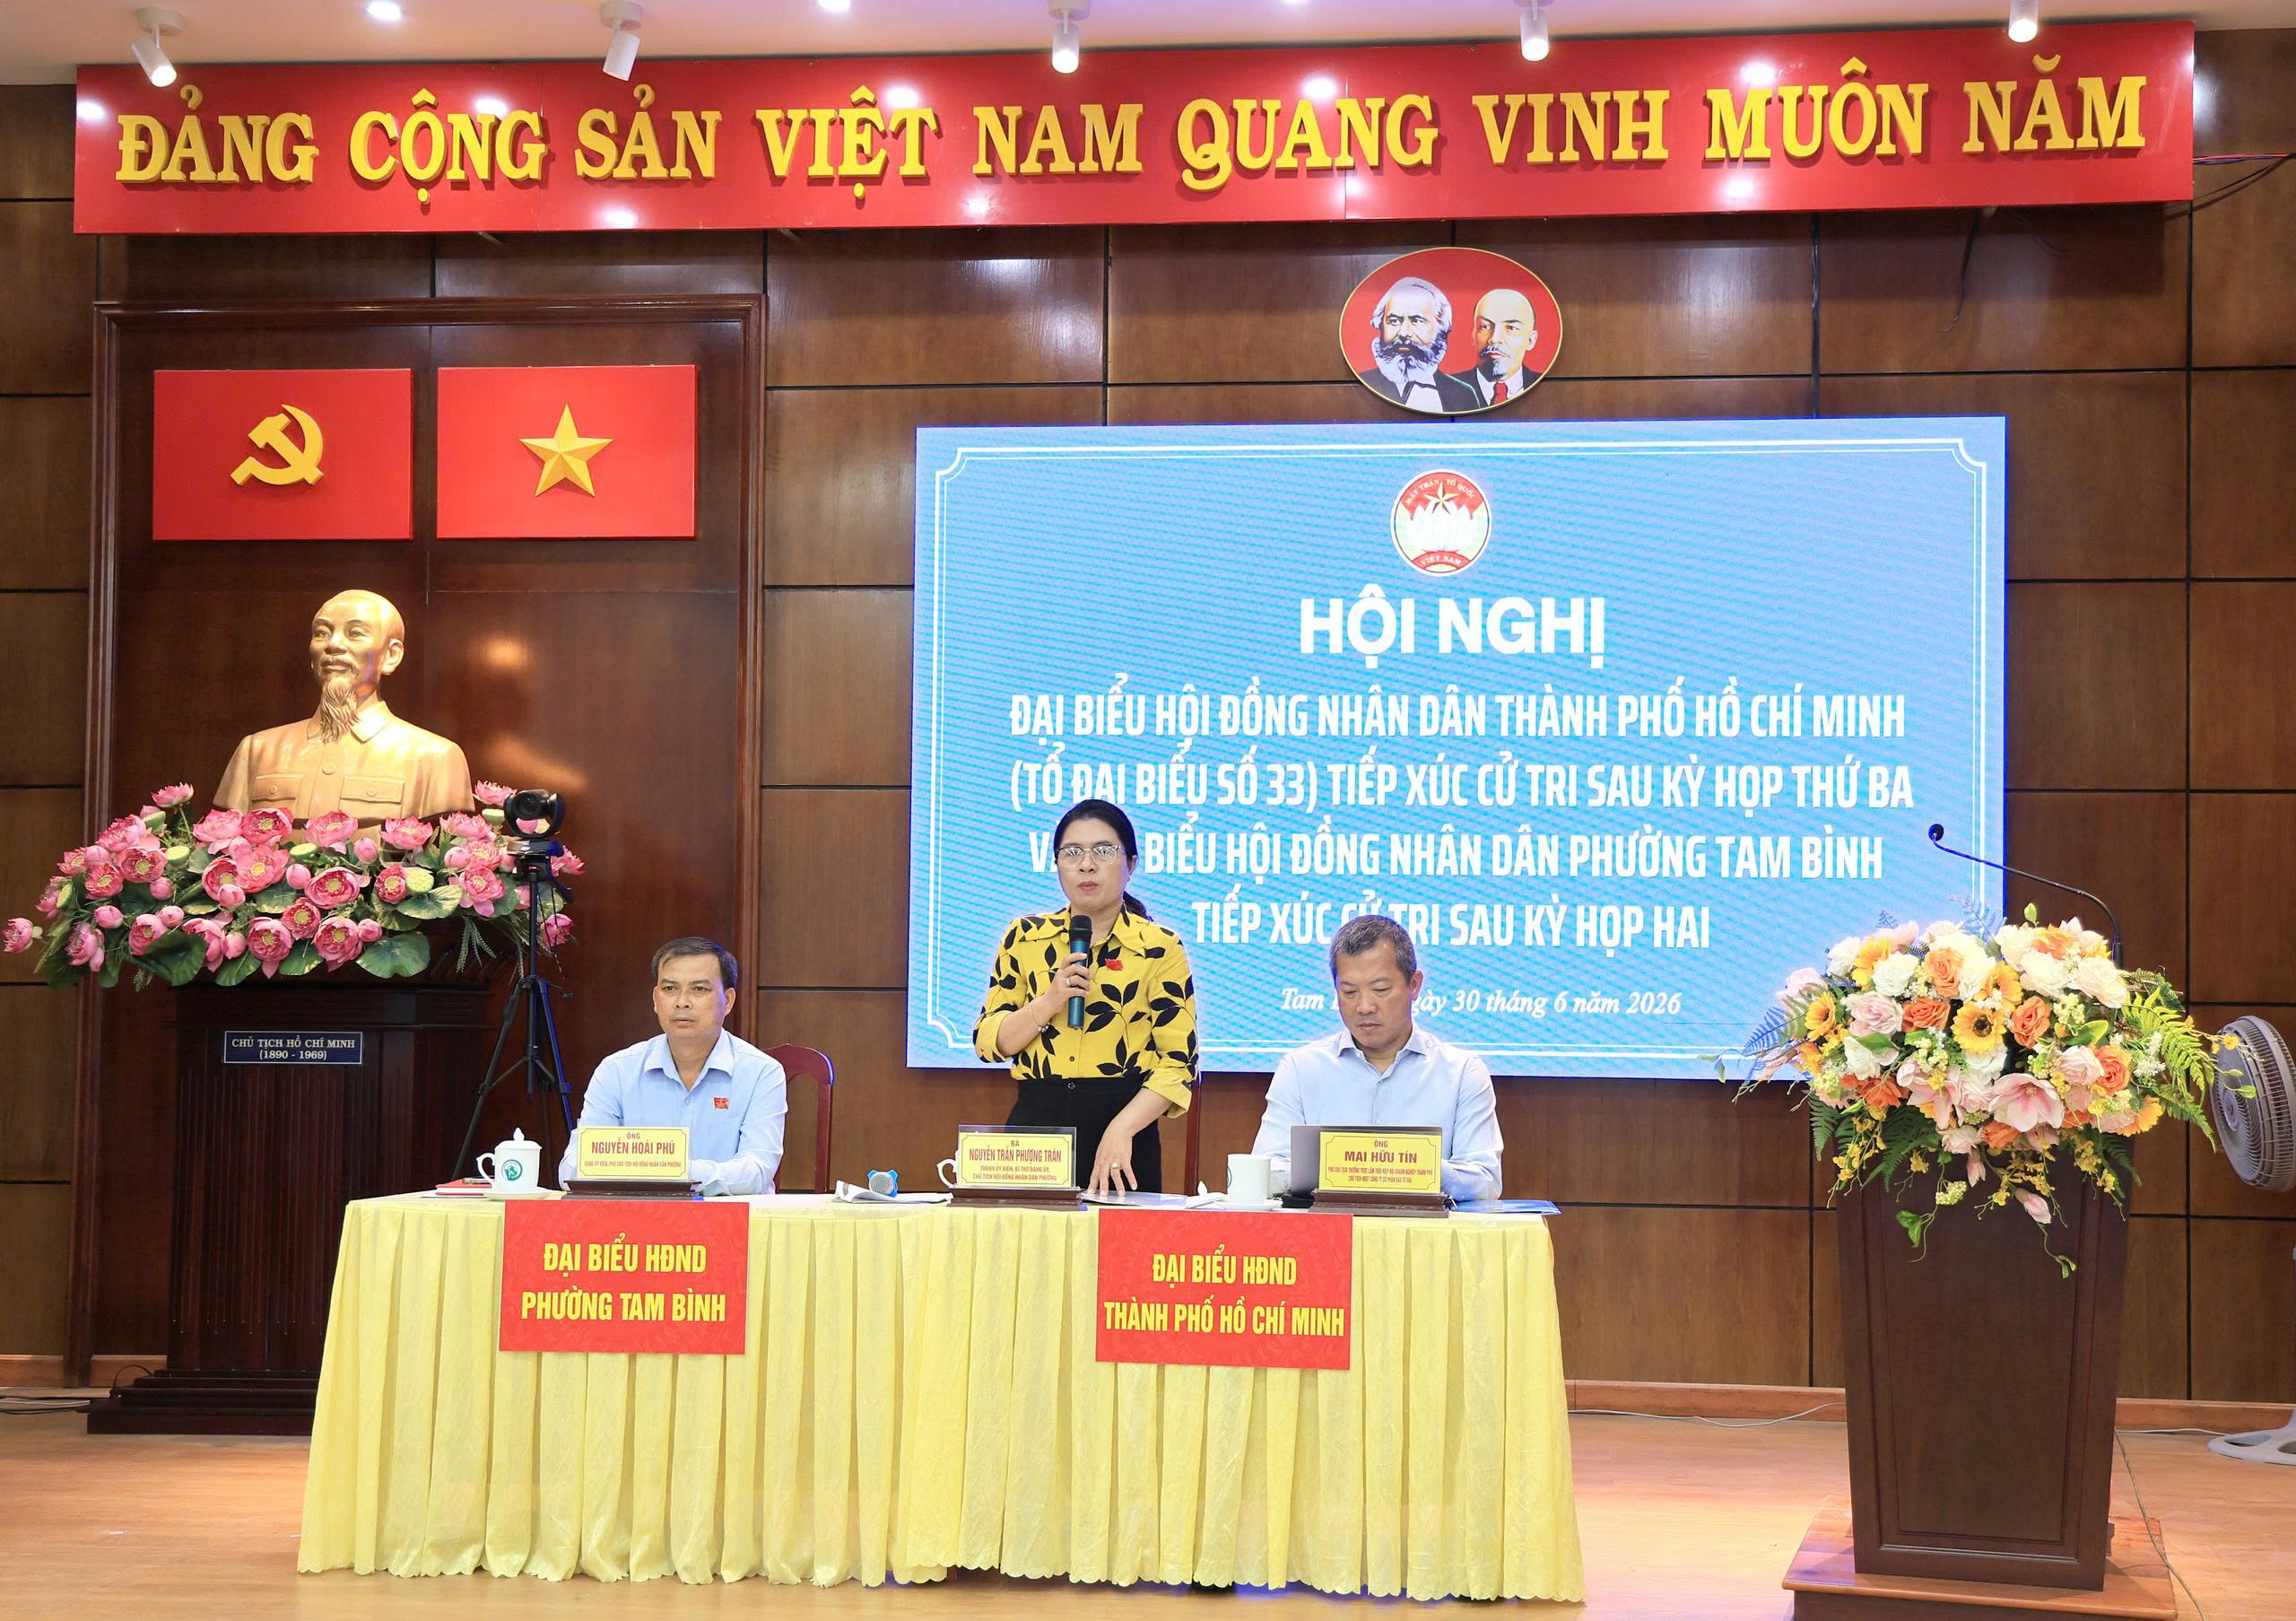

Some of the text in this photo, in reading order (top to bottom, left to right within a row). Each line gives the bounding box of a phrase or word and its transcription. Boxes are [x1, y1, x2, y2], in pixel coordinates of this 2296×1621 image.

[116, 53, 2147, 204] ĐẢNG CỘNG SẢN VIỆT NAM QUANG VINH MUÔN NĂM
[1300, 583, 1605, 668] HỘI NGHỊ
[1010, 673, 1905, 745] ĐẠI BIỂU HỘI ĐỒNG NHÂN DÂN THÀNH PHỐ HỒ CHÍ MINH
[1011, 741, 1063, 813] (TỔ
[1135, 743, 1207, 805] BIỂU
[1217, 745, 1258, 806] SỐ
[1269, 762, 1318, 814] 33)
[1327, 745, 1396, 806] TIẾP
[1405, 753, 1468, 806] XÚC
[1477, 751, 1519, 806] CỬ
[1526, 764, 1577, 807] TRI
[1587, 764, 1652, 807] SAU
[1663, 754, 1706, 807] KỲ
[1715, 765, 1783, 817] HỌP
[1791, 754, 1861, 808] THỨ
[1869, 766, 1914, 808] BA
[1144, 810, 1215, 875] BIỂU
[1226, 822, 1281, 886] HỘI
[1291, 810, 1379, 876] ĐỒNG
[1390, 823, 1482, 876] NHÂN
[1492, 824, 1560, 877] DÂN
[1570, 824, 1706, 878] PHƯỜNG
[1715, 835, 1791, 879] TAM
[1801, 824, 1883, 879] BÌNH
[1191, 884, 1261, 945] TIẾP
[1269, 891, 1332, 946] XÚC
[1388, 903, 1439, 945] TRI
[1449, 903, 1514, 946] SAU
[1525, 893, 1568, 946] KỲ
[1576, 905, 1643, 958] HỌP
[1653, 906, 1709, 948] HAI
[1281, 988, 1325, 1010] Tam
[1412, 989, 1448, 1016] gày
[1453, 990, 1480, 1012] 30
[1485, 989, 1548, 1018] tháng
[1552, 990, 1566, 1013] 6
[1572, 991, 1619, 1014] năm
[1626, 992, 1682, 1015] 2026
[231, 1034, 355, 1049] CHỦ TỊCH HỒ CHÍ MINH
[259, 1050, 288, 1060] (1890
[299, 1050, 327, 1060] 1969)
[592, 1137, 629, 1155] NGUYỄN
[657, 1139, 675, 1155] PHÚ
[970, 1145, 995, 1162] NGUYỄN
[1344, 1149, 1417, 1163] MAI HỮU TÍN
[1374, 1139, 1388, 1147] ÔNG
[544, 1233, 707, 1277] ĐẠI BIỂU HĐND
[1152, 1243, 1297, 1288] ĐẠI BIỂU HĐND
[521, 1285, 726, 1321] PHƯỜNG TAM BÌNH
[1104, 1294, 1344, 1337] THÀNH PHỐ HỒ CHÍ MINH
